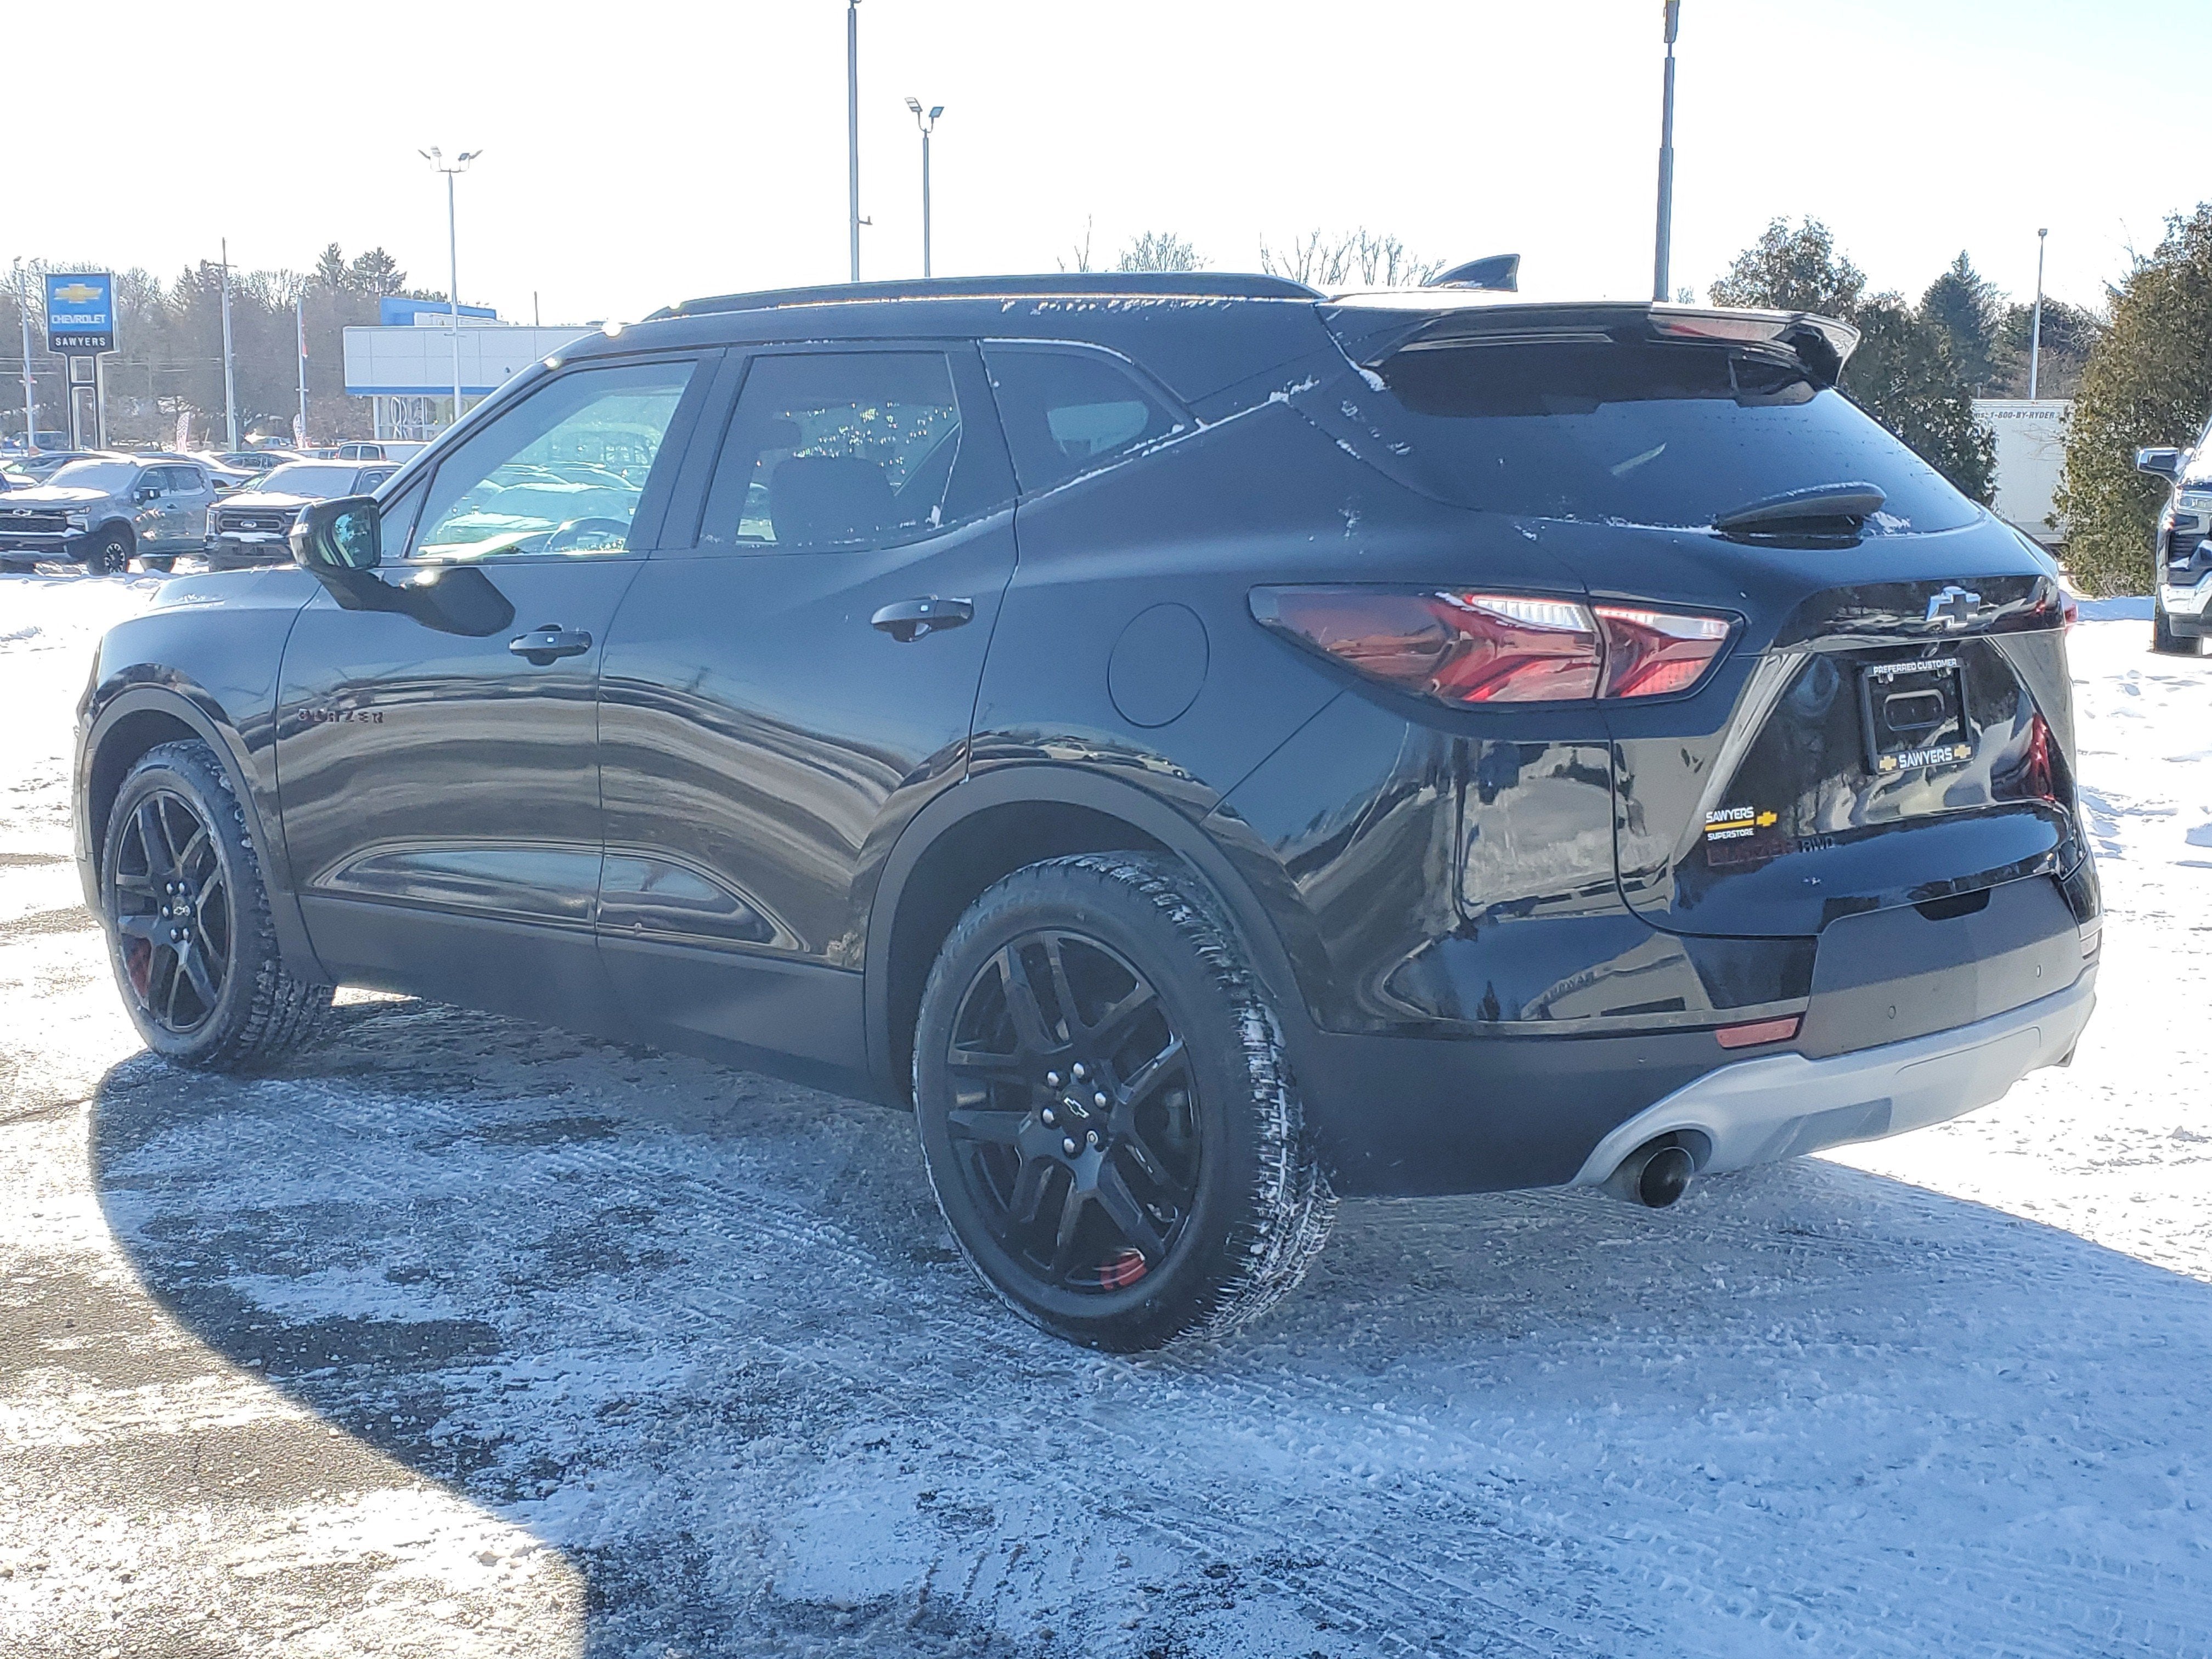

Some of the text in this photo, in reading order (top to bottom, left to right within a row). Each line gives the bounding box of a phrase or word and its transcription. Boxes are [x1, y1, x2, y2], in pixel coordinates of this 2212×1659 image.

[52, 314, 106, 324] CHEVROLET
[55, 337, 106, 346] SAWYERS
[1873, 658, 1957, 675] PREFERRED CUSTOMER
[1899, 748, 1953, 769] SAWYERS
[1706, 806, 1754, 823] SAWYERS
[1707, 828, 1754, 841] SUPERSTORE
